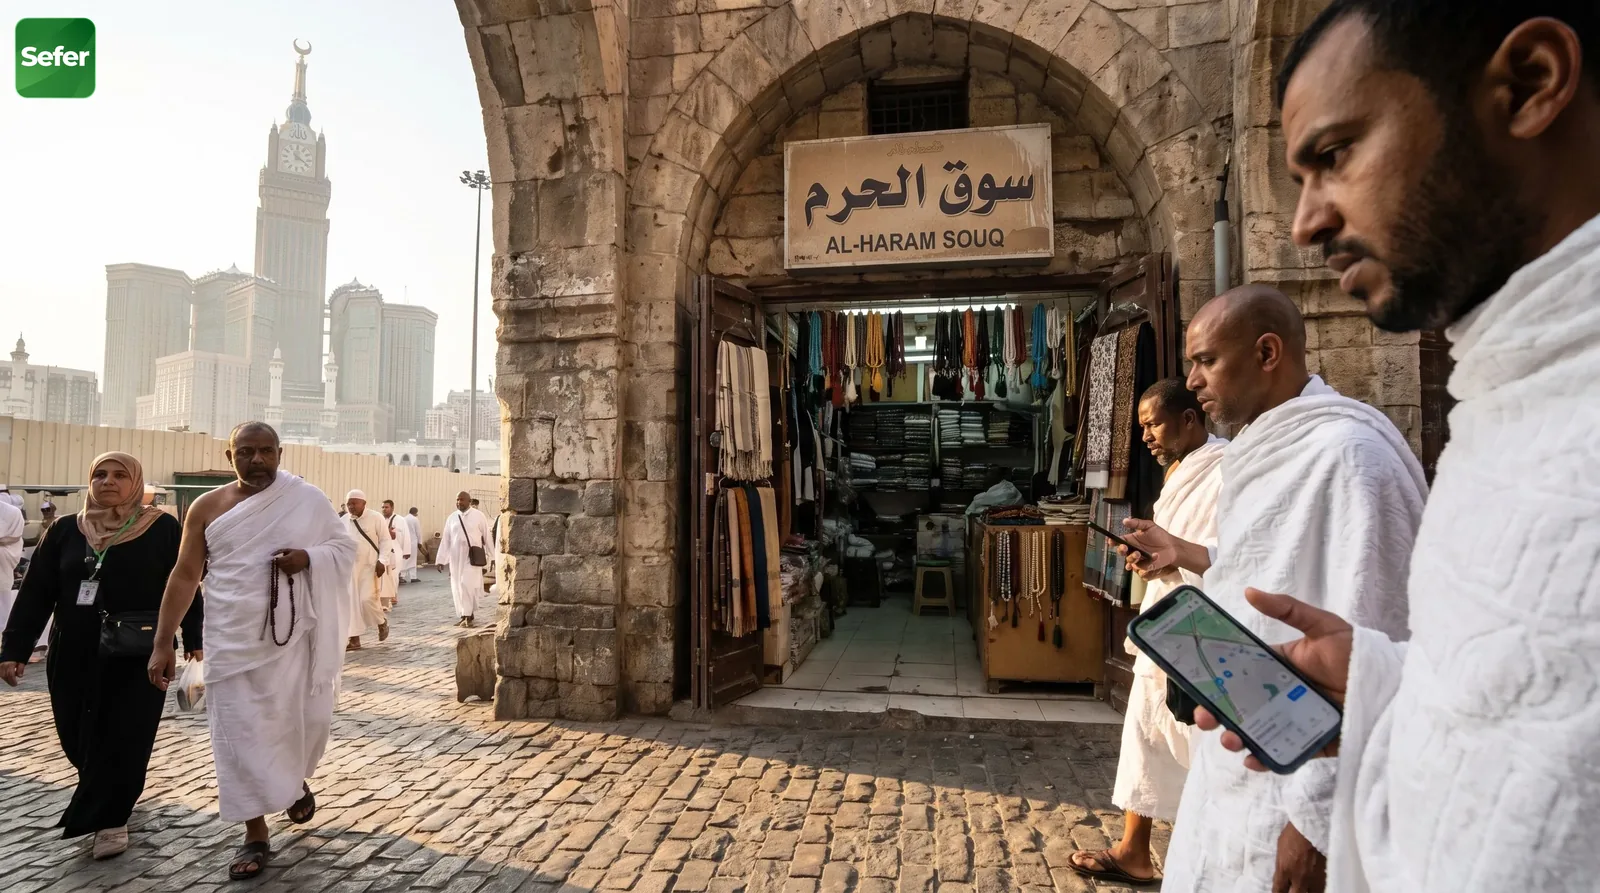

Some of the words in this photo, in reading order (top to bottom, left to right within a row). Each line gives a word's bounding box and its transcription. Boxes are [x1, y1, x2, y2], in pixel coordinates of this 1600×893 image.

[804, 163, 926, 227] الحرم
[939, 159, 1034, 216] سوق
[825, 231, 936, 254] AL-HARAM
[943, 228, 1005, 248] SOUQ
